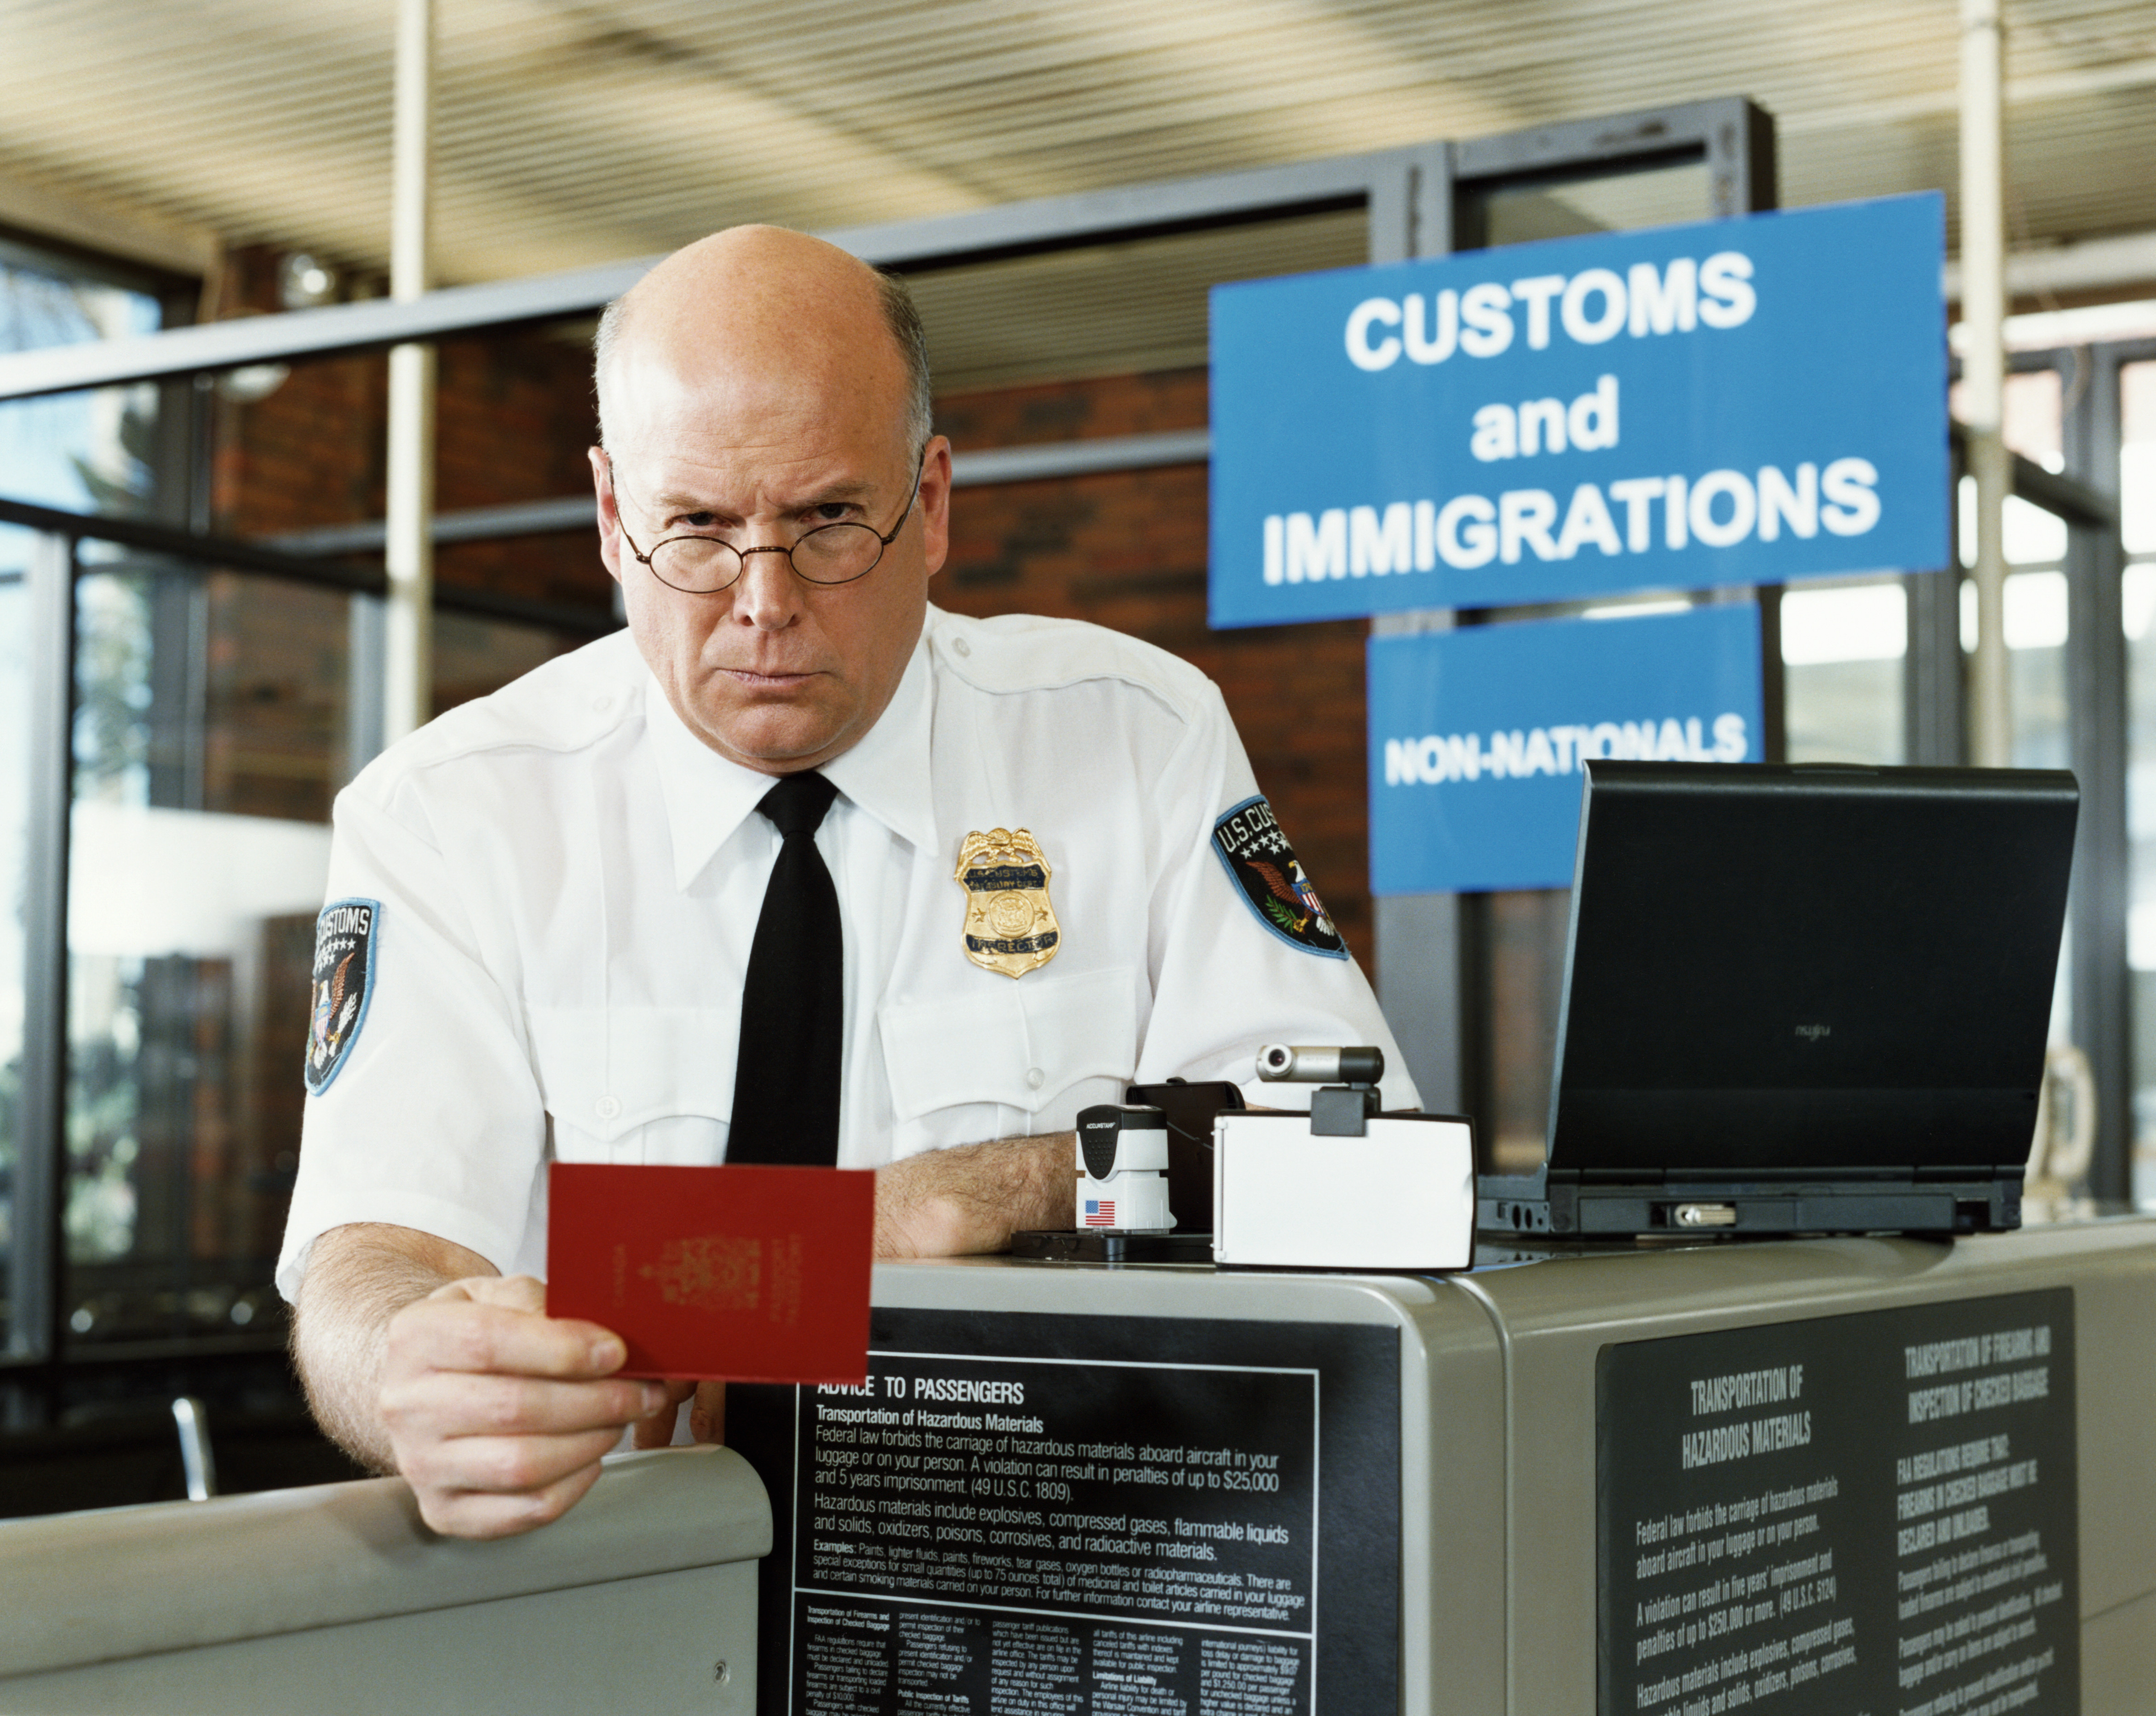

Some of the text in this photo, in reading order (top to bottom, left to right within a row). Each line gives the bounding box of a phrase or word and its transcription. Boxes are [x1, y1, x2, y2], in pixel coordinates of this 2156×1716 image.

[1344, 251, 1757, 372] CUSTOMS
[1469, 374, 1619, 462] and
[1262, 457, 1881, 586] IMMIGRATIONS
[1385, 712, 1747, 786] NON-NATIONALS
[884, 1376, 906, 1398] TO
[914, 1377, 1024, 1404] PASSENGERS
[1691, 1363, 1802, 1416] TRANSPORTATION OF
[816, 1404, 1043, 1433] Transportation of Hazardous Materials
[1682, 1409, 1811, 1469] HAZARDOUS MATERIALS
[815, 1446, 1279, 1495] luggage or on your person. A violation can result in penalties of up to $25,000
[816, 1425, 1279, 1473] Federal law forbids the carriage of hazardous materials aboard aircraft in your
[815, 1467, 1073, 1504] and 5 years imprisonment. (49 U.S.C. 1809).
[1637, 1473, 1837, 1546] Federal law forbids the carriage of hazardous materials
[814, 1492, 1289, 1547] Hazardous materials include explosives, compressed gases, flammable liquids
[814, 1514, 1217, 1561] and solids, oxidizers, poisons, corrosives, and radioactive materials.
[1637, 1512, 1818, 1579] aboard aircraft in your luggage or on your person.
[814, 1539, 1291, 1590] Examples: Paints, lighter fluids, paints, fireworks, tear gases, oxygen bottles or radiopharmaceuticals. There are
[814, 1553, 1304, 1609] special exceptions for small quantities (up to 75 ounces total) of medicinal and toilet articles carried in your luggage
[813, 1567, 1289, 1623] and certain smoking materials carried on your person. For further information contact your airline representative.
